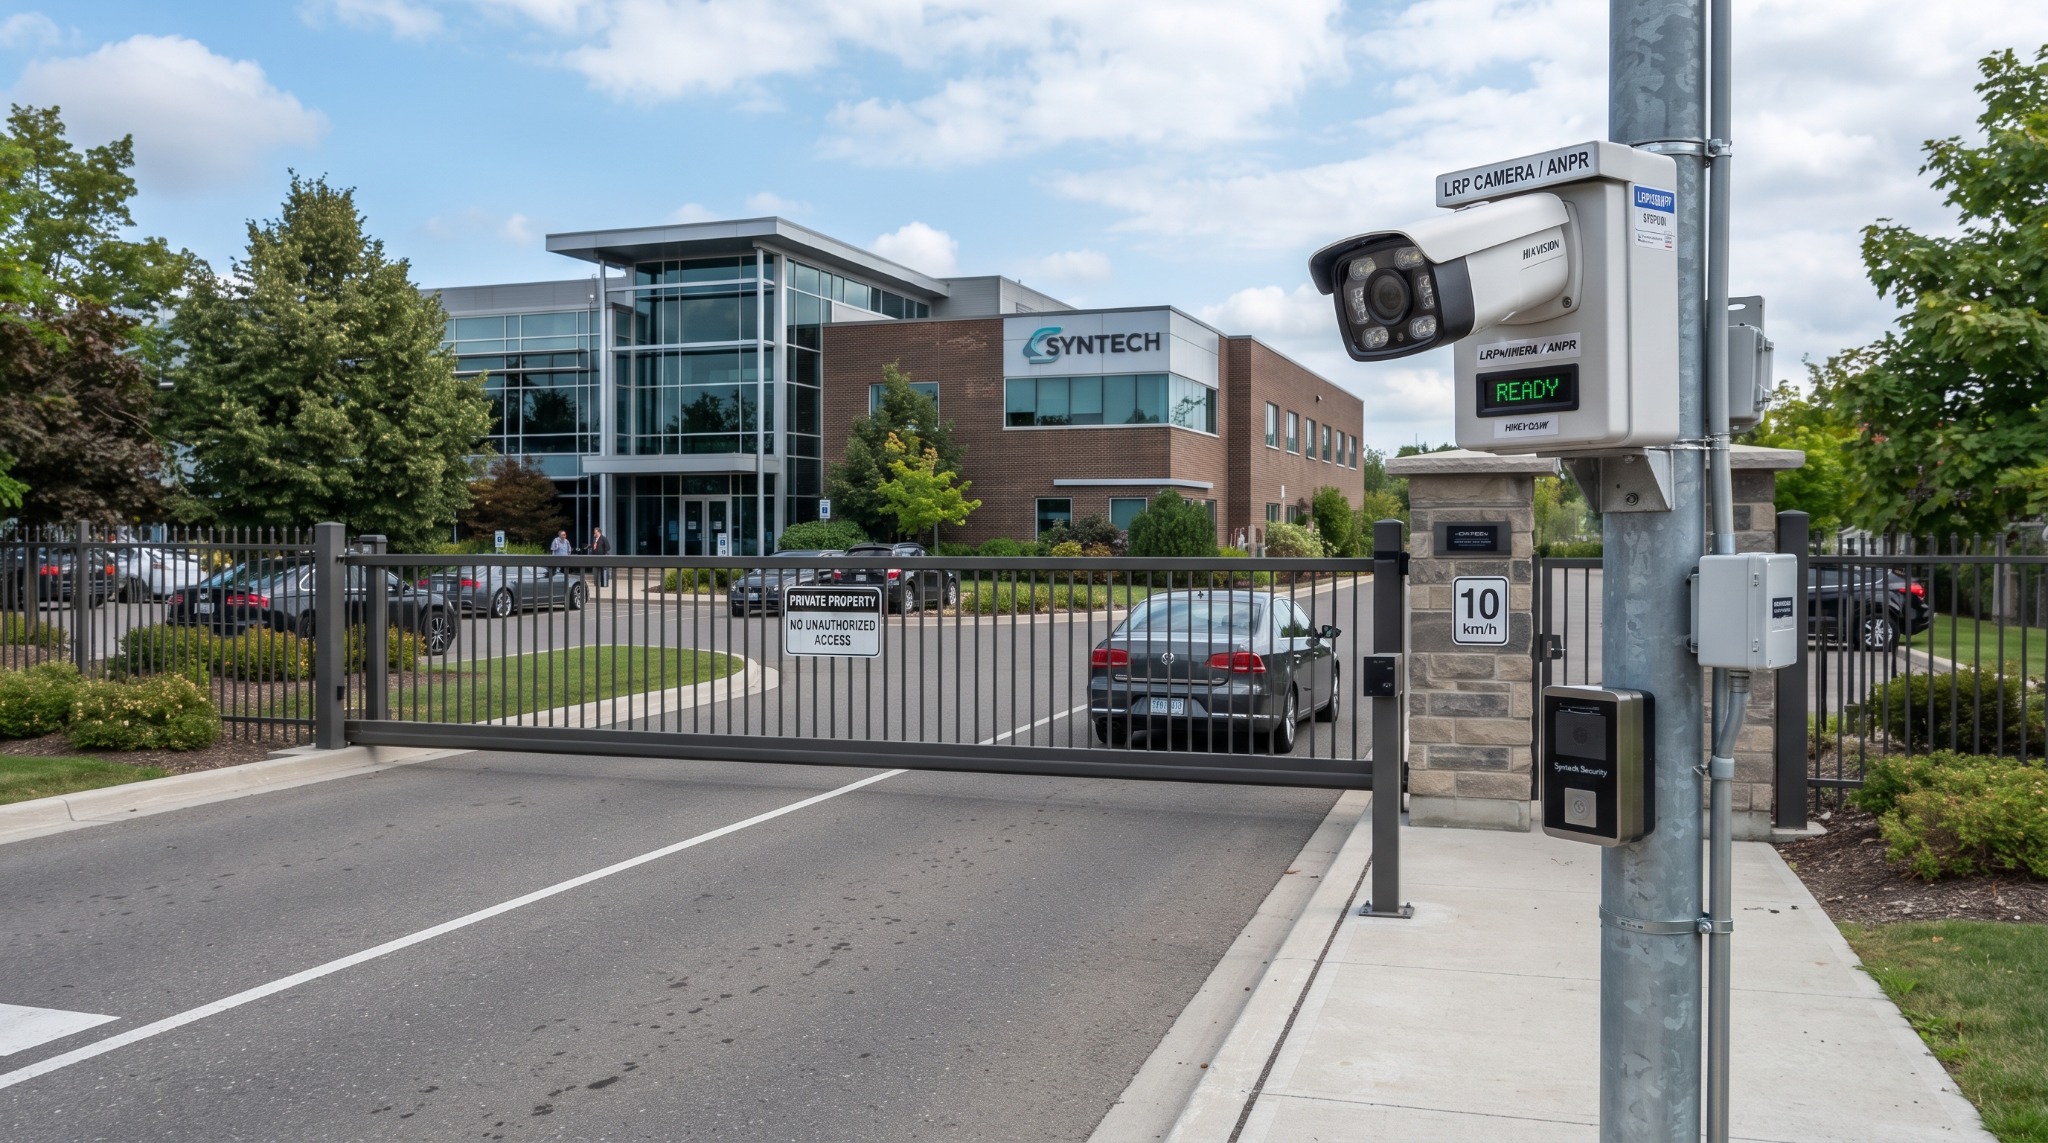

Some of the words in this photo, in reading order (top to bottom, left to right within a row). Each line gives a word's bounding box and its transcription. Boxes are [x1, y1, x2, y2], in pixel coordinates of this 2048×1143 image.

[1444, 177, 1470, 197] LRP
[1474, 164, 1535, 190] CAMERA
[1538, 160, 1543, 178] /
[1547, 151, 1590, 176] ANPR
[1046, 332, 1161, 356] SYNTECH
[1547, 340, 1577, 353] ANPR
[1496, 378, 1559, 402] READY
[789, 595, 827, 607] PRIVATE
[828, 595, 876, 607] PROPERTY
[1460, 588, 1500, 620] 10
[790, 619, 803, 631] NO
[805, 619, 876, 631] UNAUTHORIZED
[1463, 623, 1497, 635] km/h
[814, 634, 851, 646] ACCESS
[1580, 765, 1607, 778] Security
